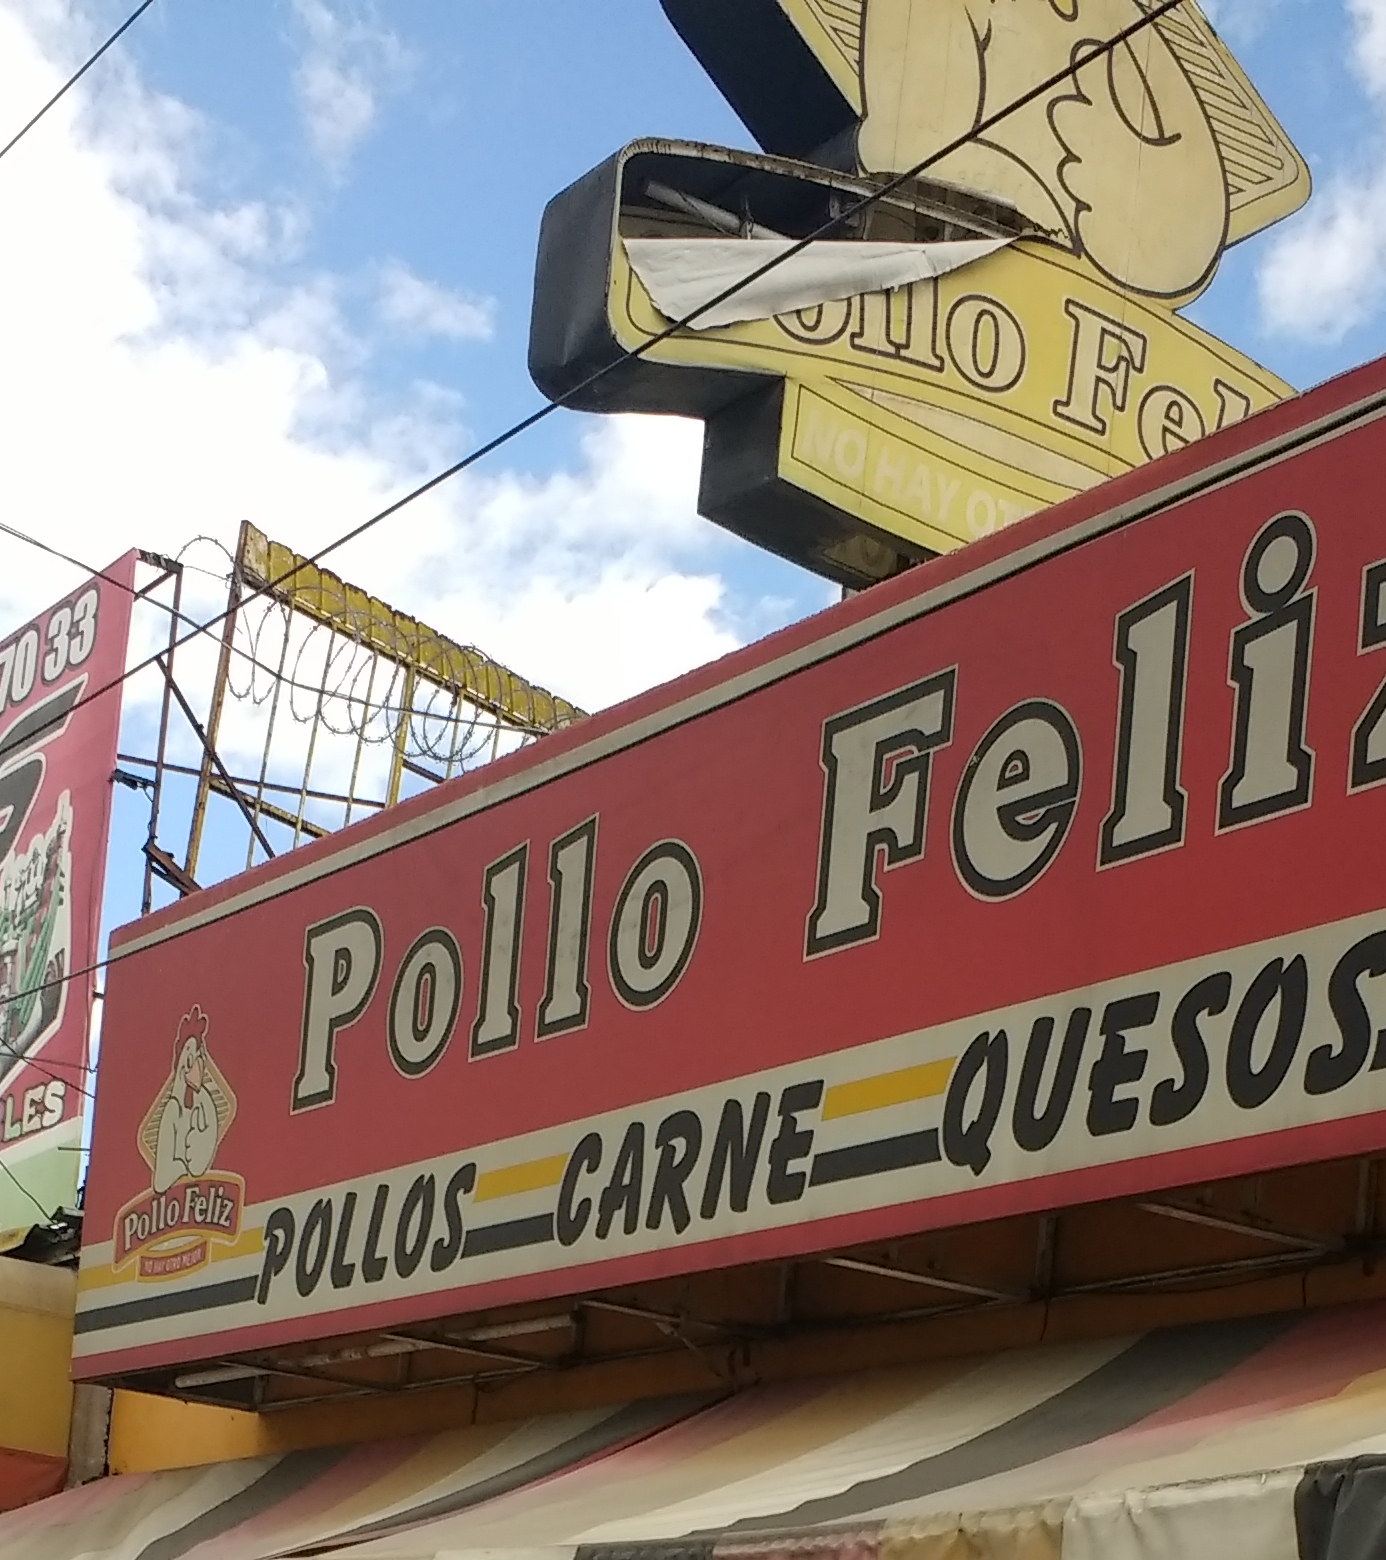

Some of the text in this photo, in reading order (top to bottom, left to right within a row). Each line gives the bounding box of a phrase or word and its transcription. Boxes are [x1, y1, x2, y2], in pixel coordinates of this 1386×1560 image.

[801, 418, 866, 475] NO
[873, 446, 962, 523] HAY
[41, 582, 101, 684] 33
[290, 812, 704, 1116] Pollo
[124, 1186, 234, 1251] Pollo Feliz
[257, 1162, 479, 1306] POLLOS
[555, 1079, 825, 1248] CARNE
